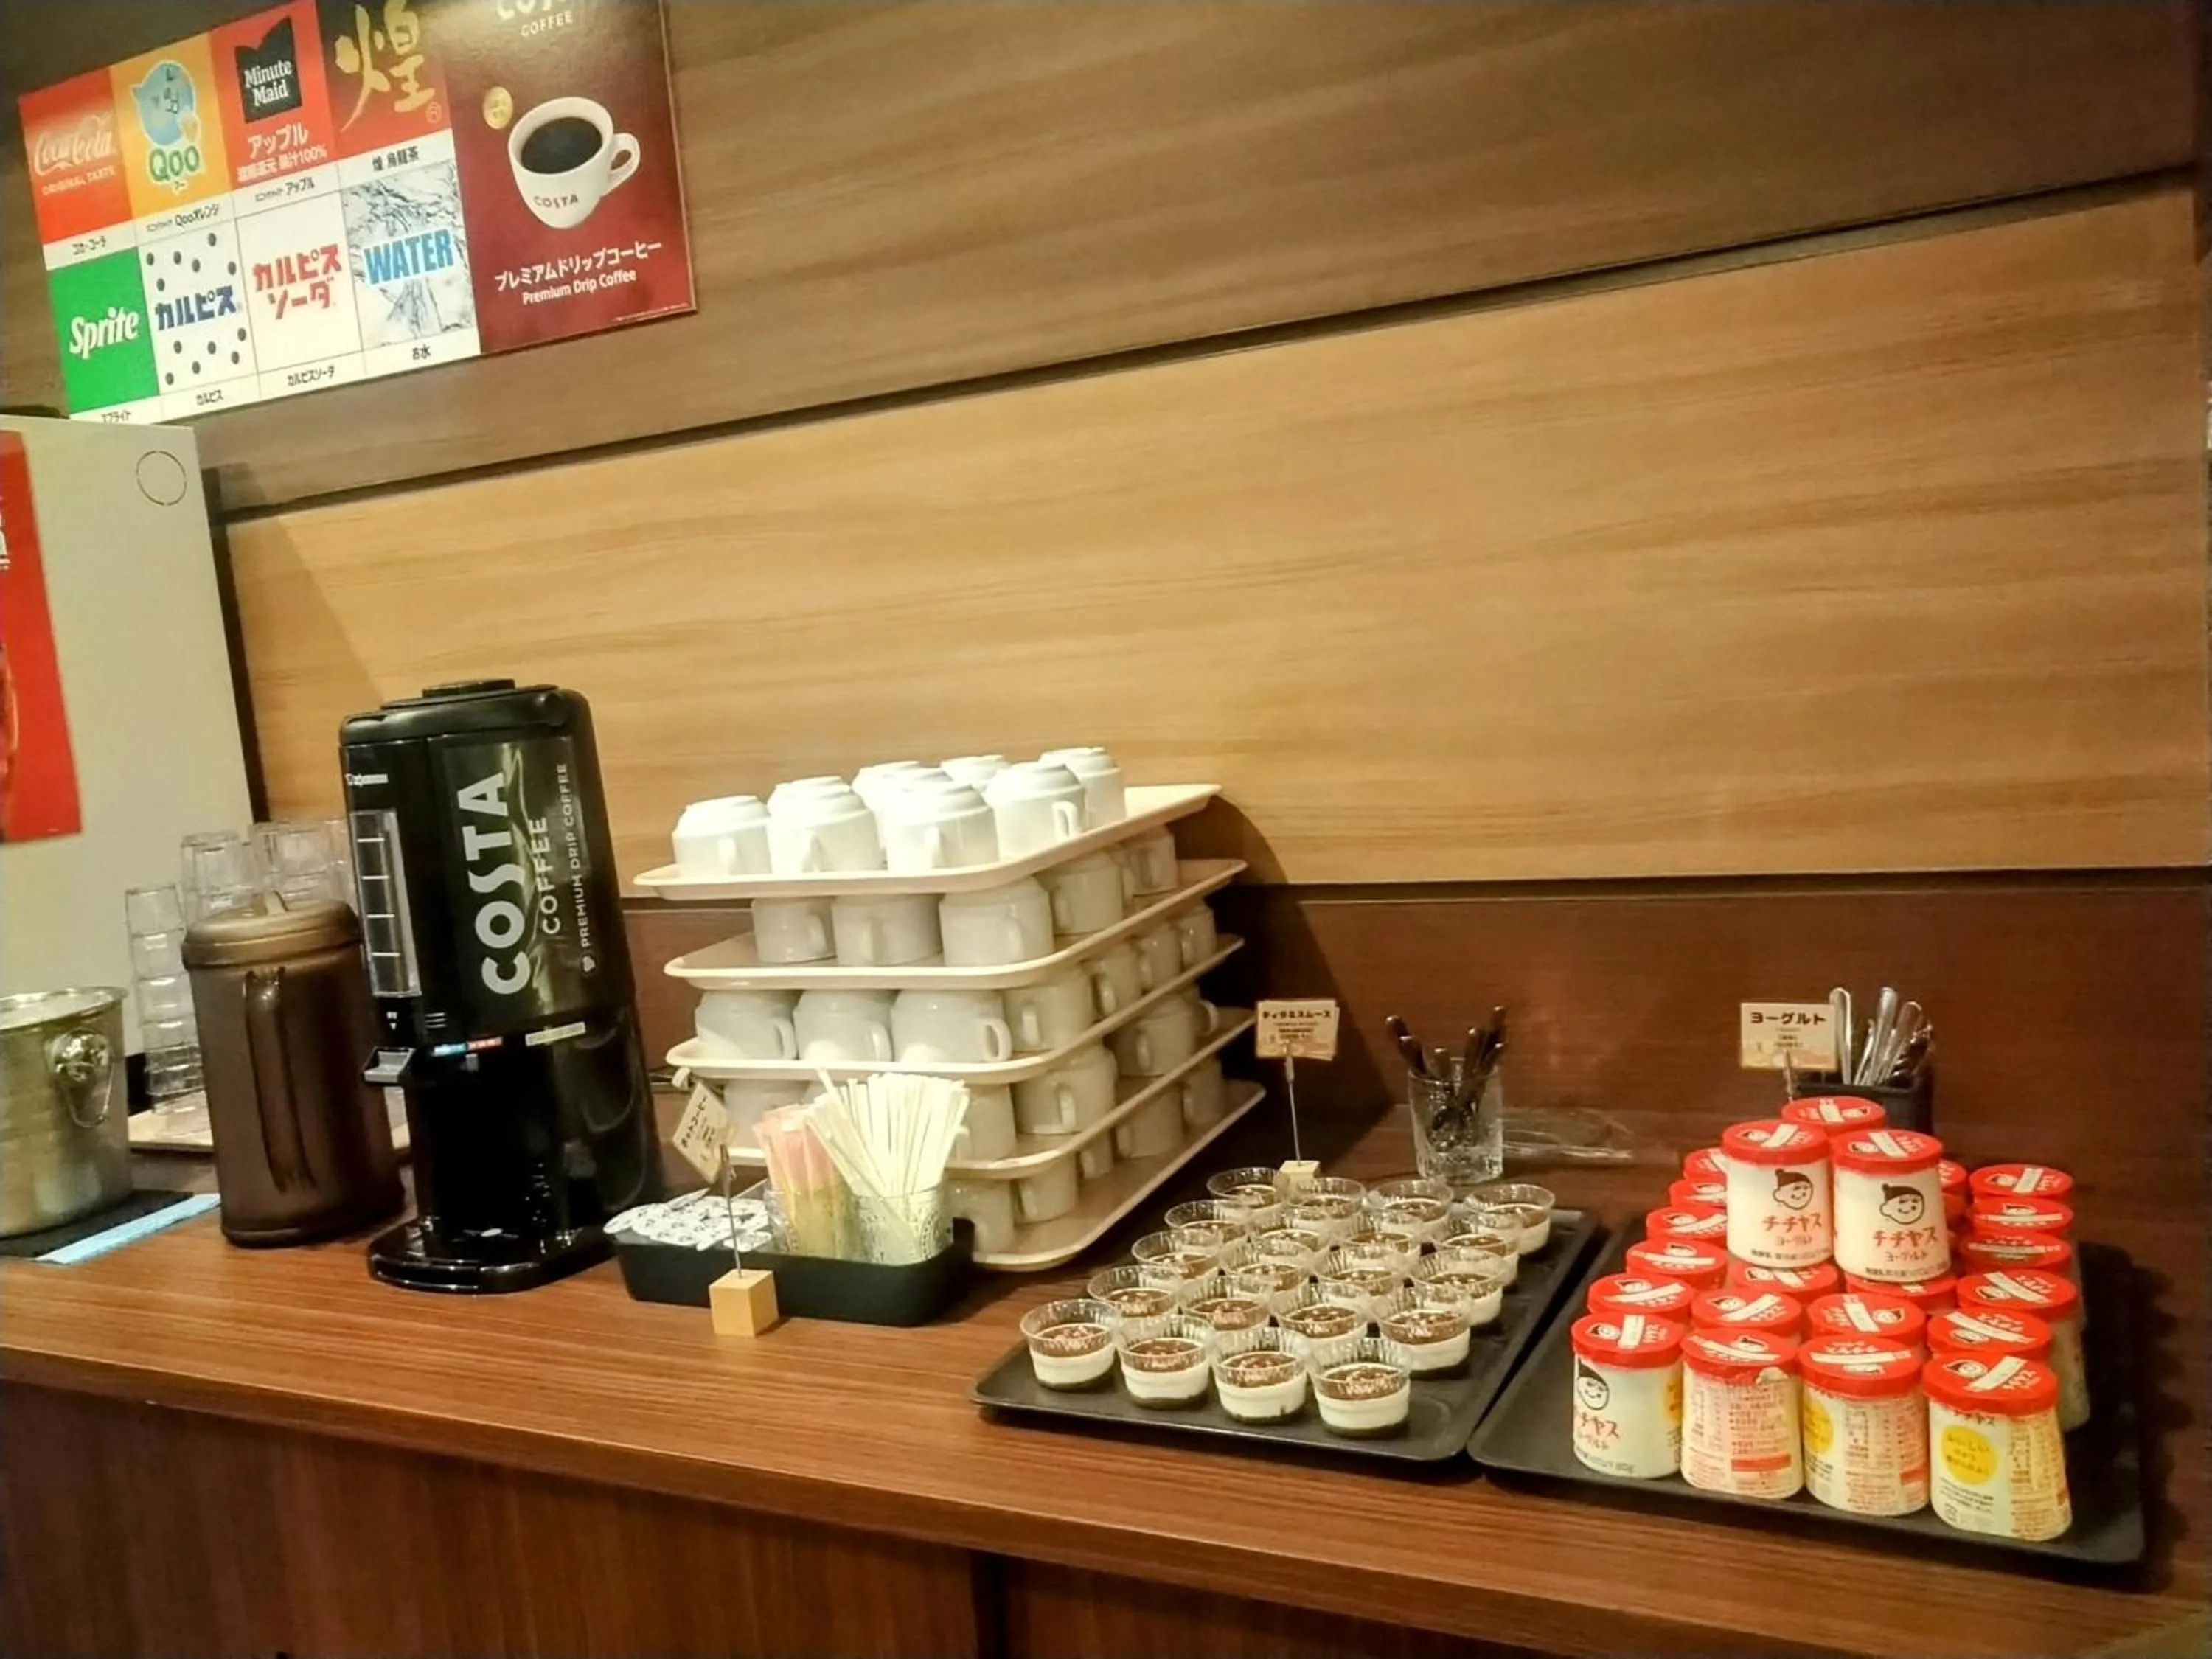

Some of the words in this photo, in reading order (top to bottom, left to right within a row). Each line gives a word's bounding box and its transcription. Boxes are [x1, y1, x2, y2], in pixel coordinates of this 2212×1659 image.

[520, 10, 573, 37] COFFEE
[243, 55, 293, 87] Minute
[253, 80, 289, 107] Maid
[247, 122, 308, 159] アップル
[149, 145, 201, 182] Qoo
[533, 192, 580, 209] COSTA
[252, 244, 342, 291] カルピス
[364, 229, 455, 285] WATER
[495, 240, 663, 292] プレミアムドリップコーヒー
[268, 276, 333, 319] ソーダ
[522, 283, 572, 305] Premium
[574, 277, 598, 294] Drip
[599, 268, 637, 288] Coffee
[155, 285, 238, 331] カルピス
[69, 306, 139, 360] Sprite
[195, 389, 224, 406] カルピス
[557, 763, 575, 827] COFFEE
[566, 832, 581, 870] DRIP
[457, 772, 531, 995] COSTA
[529, 816, 560, 936] COFFEE
[571, 874, 591, 948] PREMIUM
[1750, 1012, 1826, 1026] ヨーグルト
[1762, 1212, 1823, 1233] チチヤス
[1872, 1226, 1939, 1248] チチヤス
[1573, 1405, 1621, 1439] チヤス
